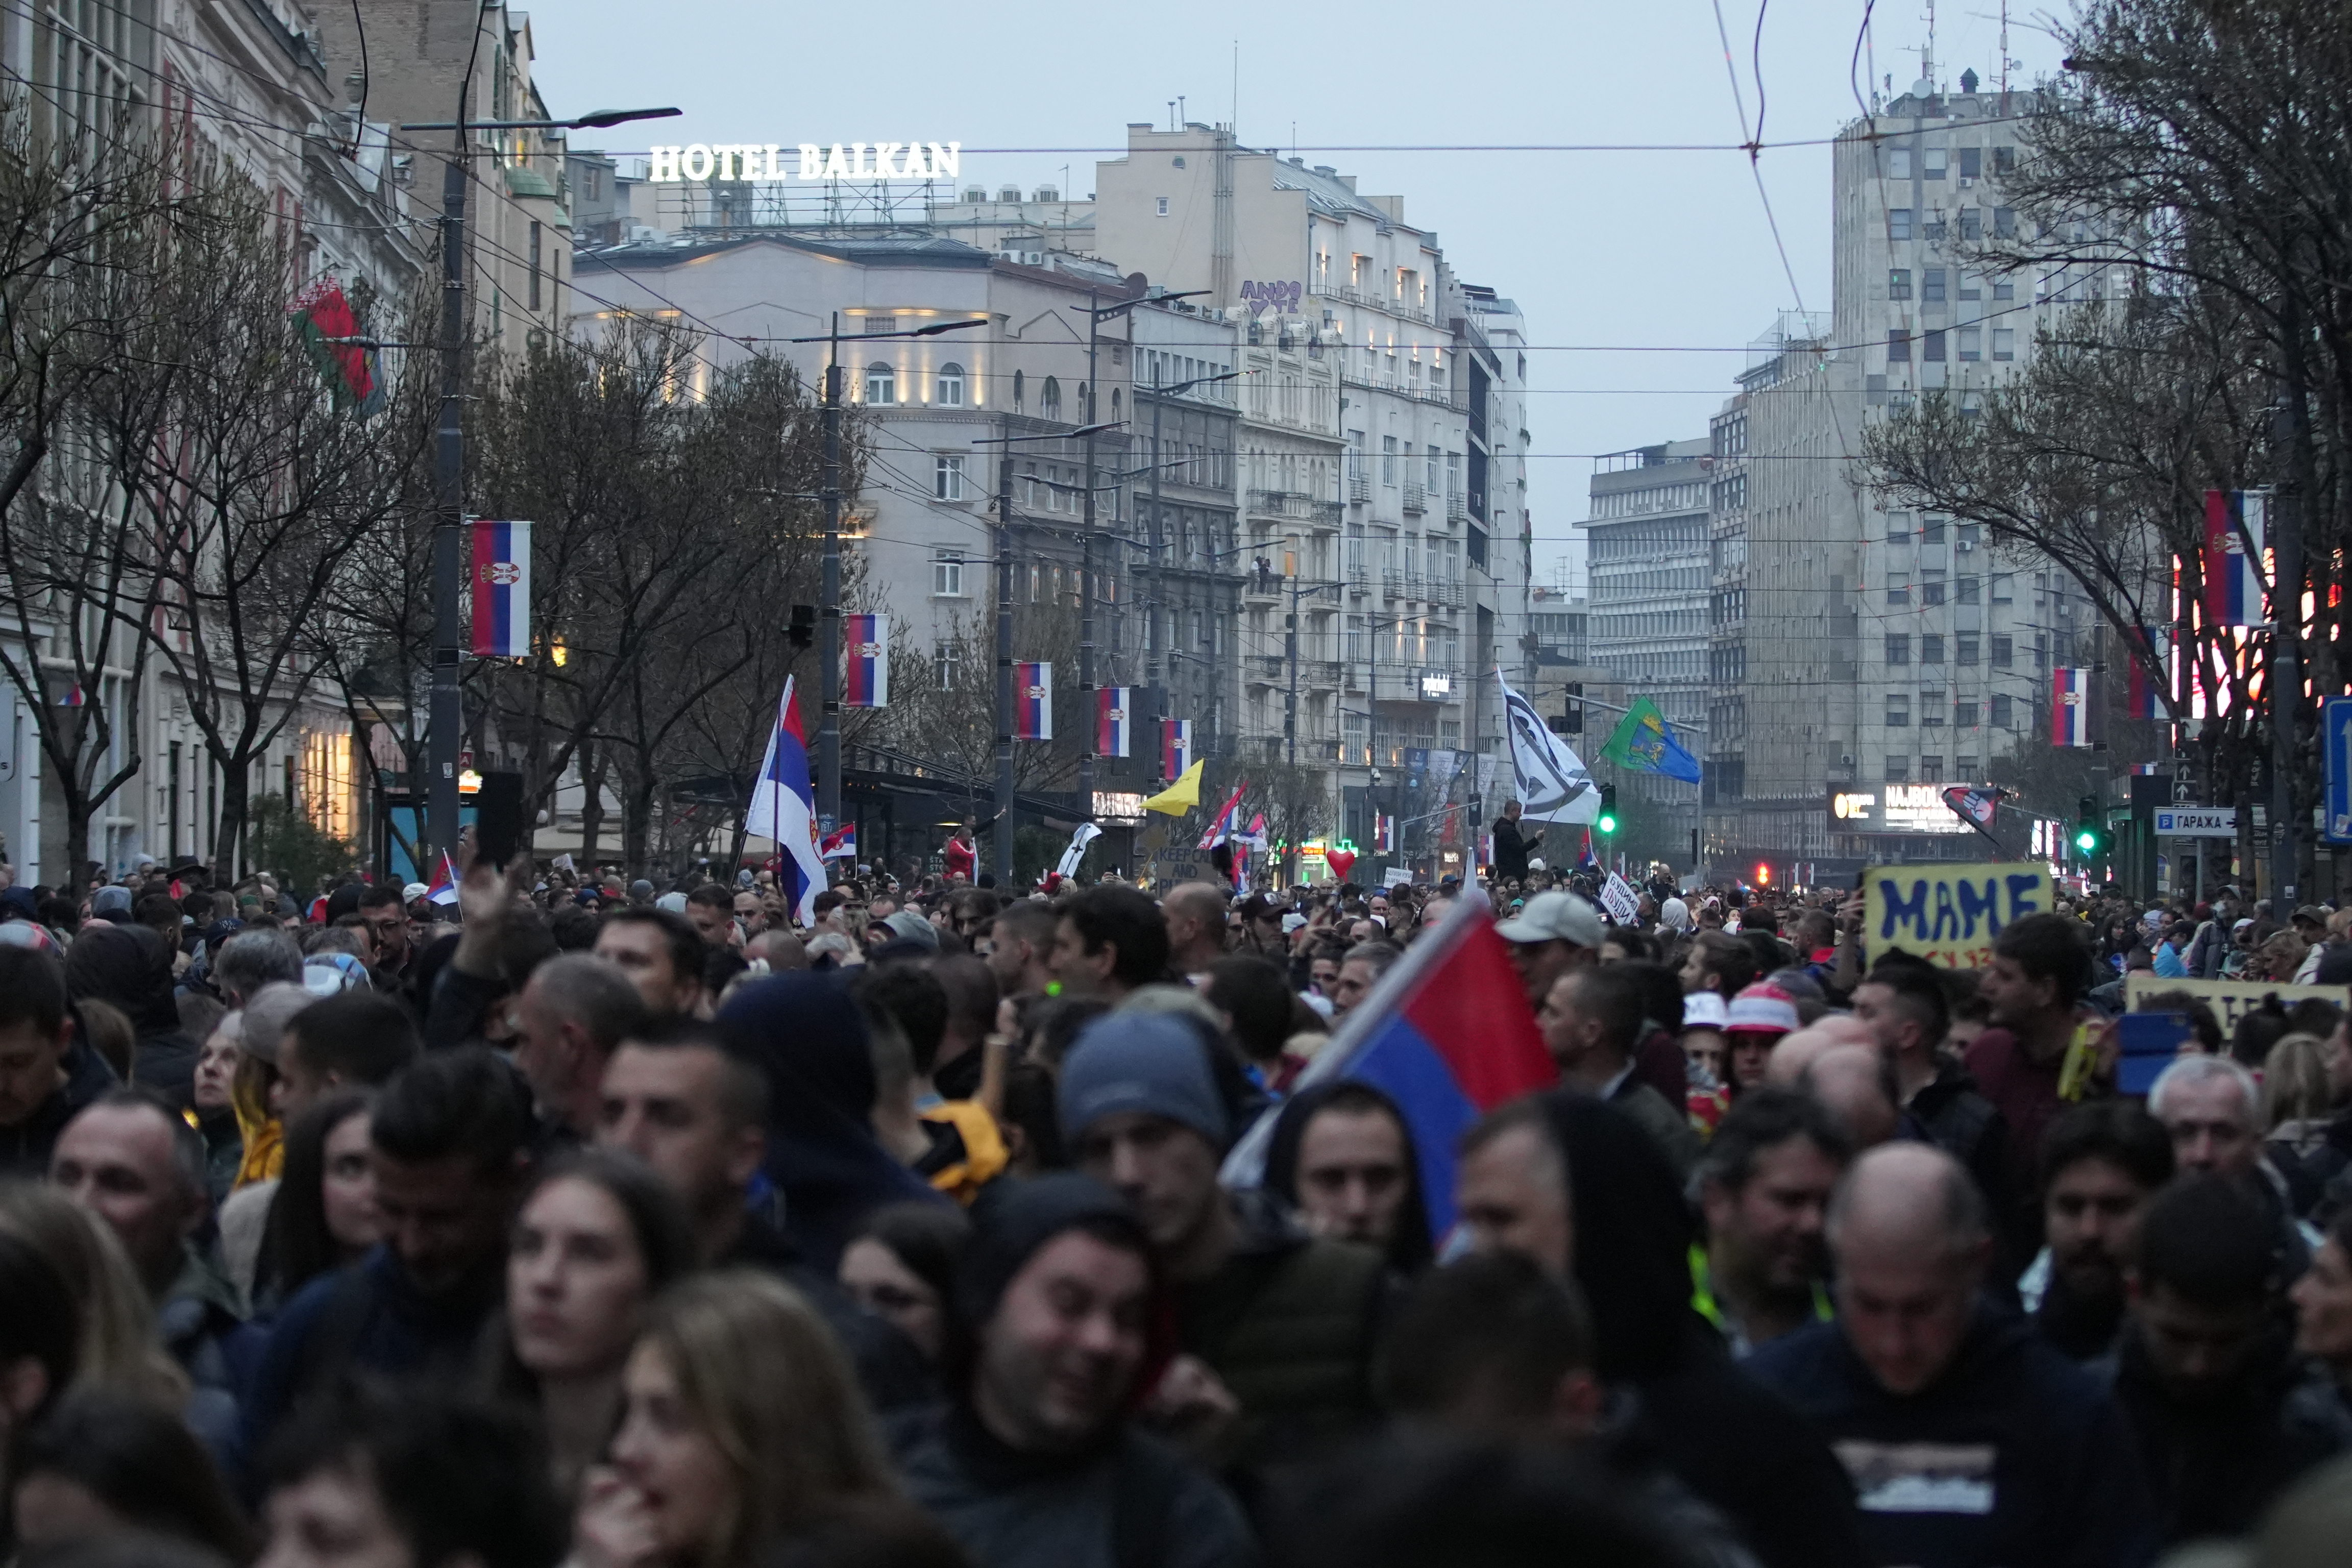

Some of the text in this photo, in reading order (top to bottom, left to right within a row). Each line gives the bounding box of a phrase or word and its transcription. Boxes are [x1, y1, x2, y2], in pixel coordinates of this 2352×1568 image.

[650, 141, 961, 182] HOTEL BALKAN
[1271, 298, 1298, 313] TE
[2177, 815, 2221, 828] ГАРАЖА
[1160, 847, 1190, 862] KEEP
[1172, 864, 1198, 878] AND
[1610, 876, 1638, 911] БУДИМО
[1604, 888, 1630, 922] ЉУДИ
